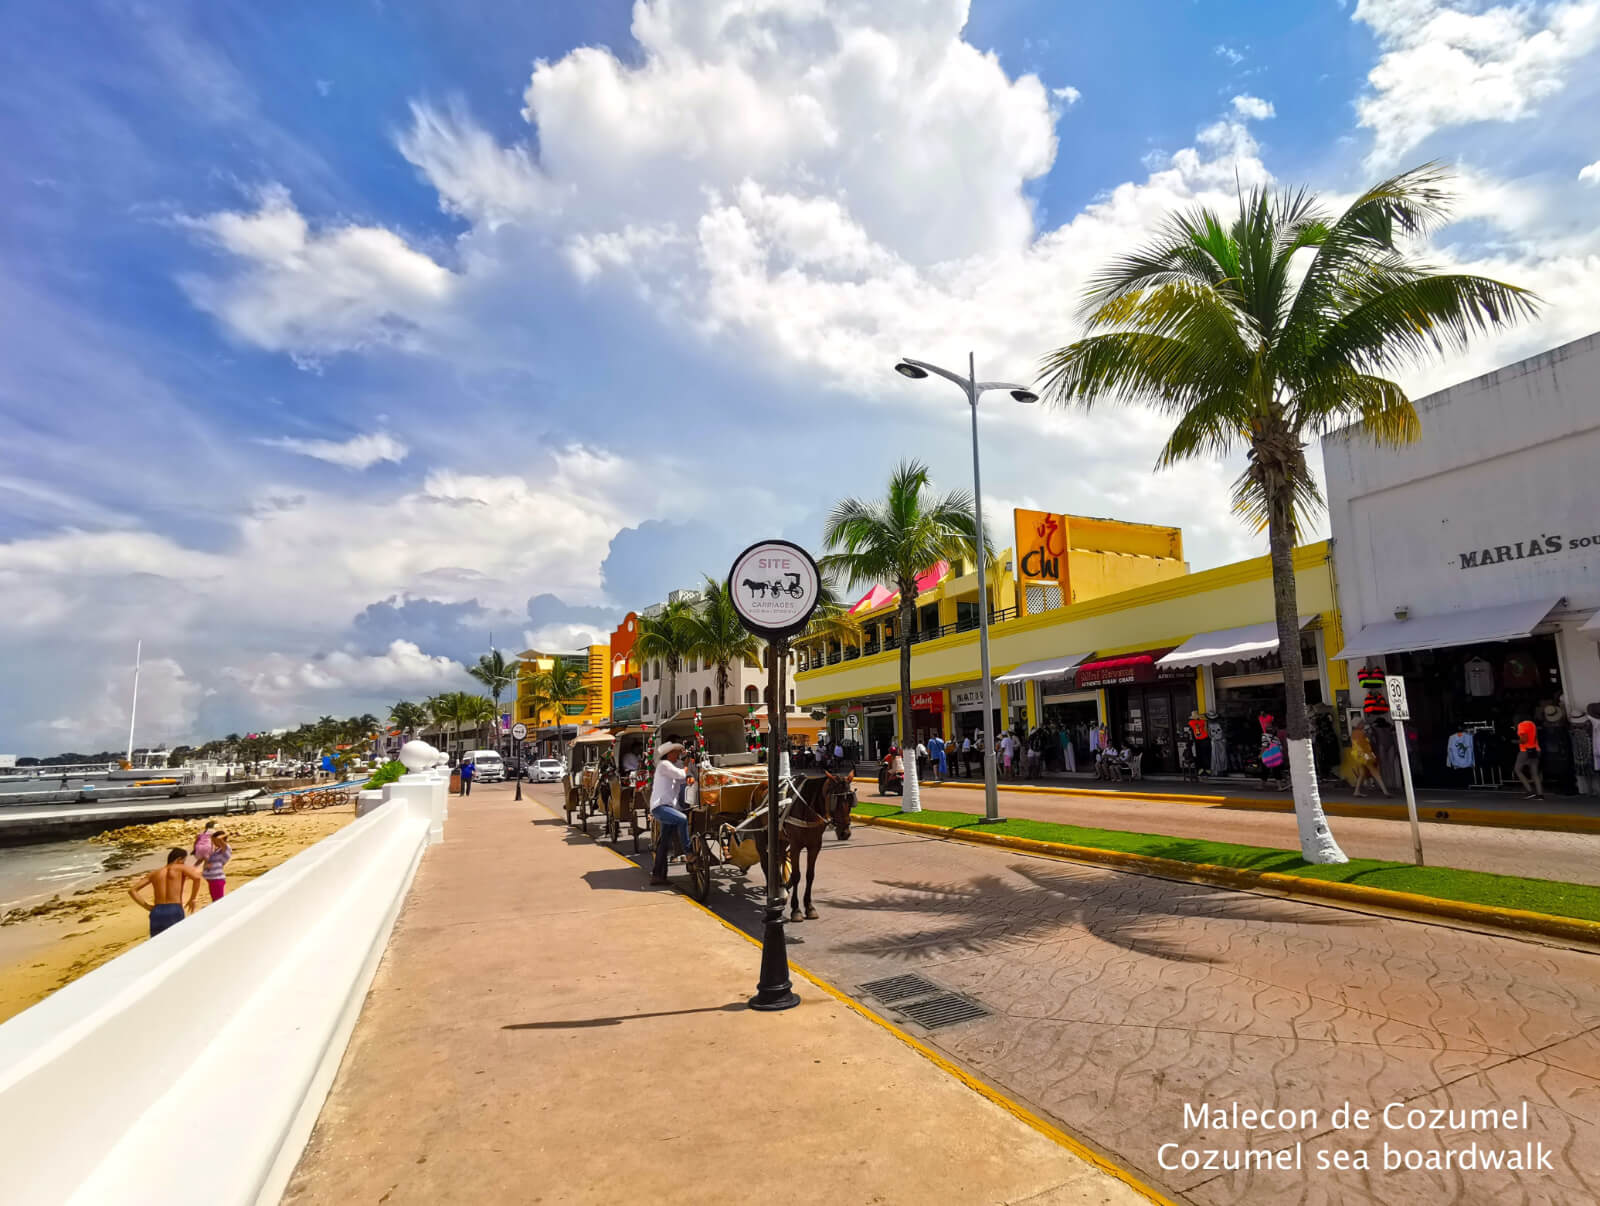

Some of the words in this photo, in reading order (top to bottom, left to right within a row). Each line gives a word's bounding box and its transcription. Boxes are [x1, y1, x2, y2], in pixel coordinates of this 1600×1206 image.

[1459, 533, 1563, 570] MARIA'S
[758, 558, 791, 569] SITE
[1390, 683, 1402, 698] 30
[849, 715, 856, 724] E
